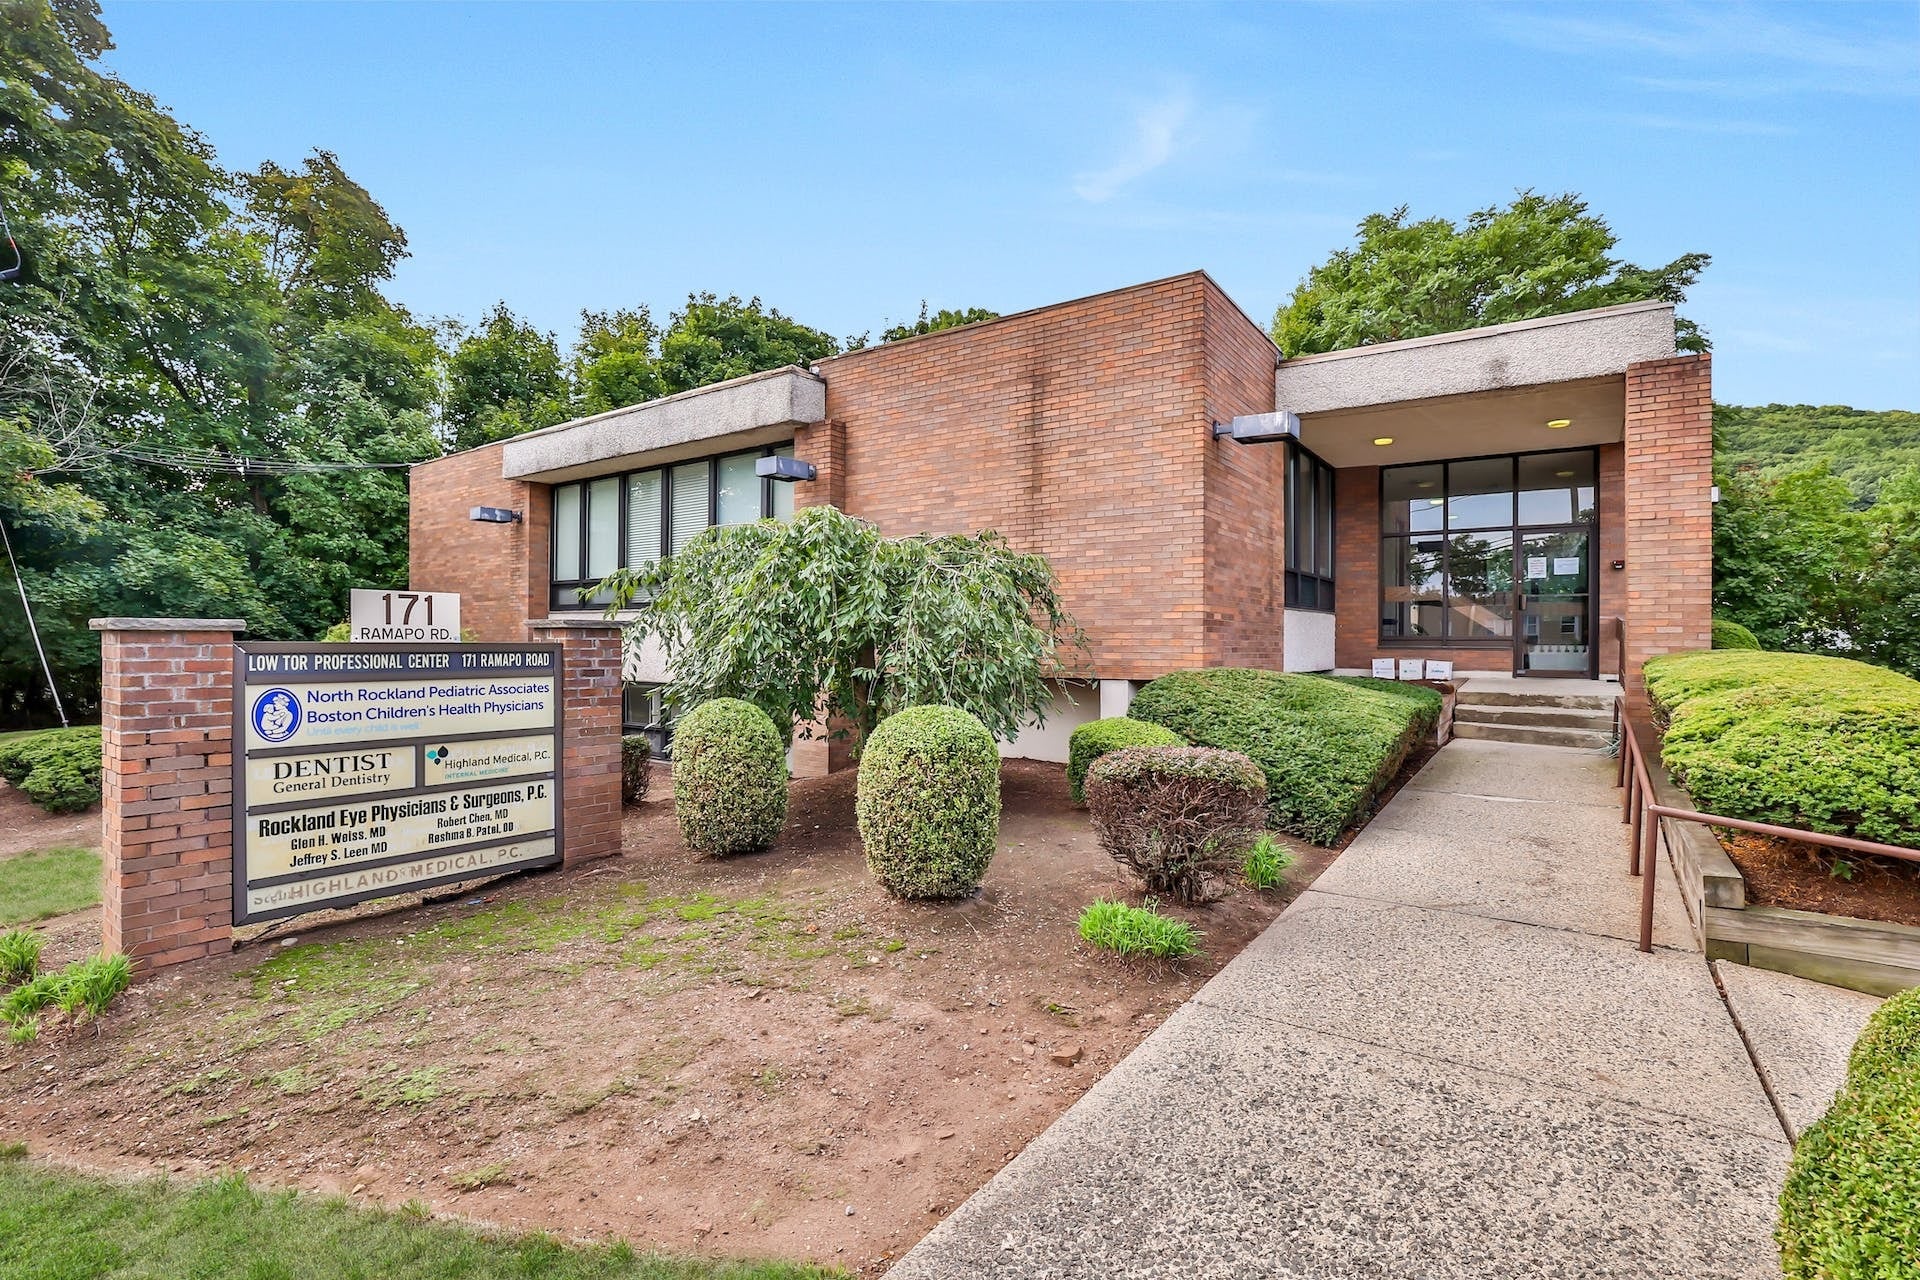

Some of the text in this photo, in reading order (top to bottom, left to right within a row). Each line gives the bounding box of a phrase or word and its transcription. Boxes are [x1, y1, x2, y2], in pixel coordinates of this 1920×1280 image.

[382, 593, 432, 625] 171
[361, 627, 452, 640] RAMAPO RD.
[248, 652, 549, 671] LOW TOR PROFESSIONAL CENTER 171 RAMAPO ROAD
[307, 682, 549, 703] North Rockland Pediatric Associates
[307, 700, 544, 723] Boston Children's Health Physicians
[273, 752, 392, 780] DENTIST
[444, 750, 550, 771] Highland Medical, P.C.
[273, 773, 390, 794] General Dentistry
[444, 767, 508, 780] INTERNAL MEDICINE
[259, 784, 547, 837] Rockland Eye Physicians & Surgeons, P.C.
[437, 815, 467, 829] Robert
[494, 808, 508, 820] MD
[291, 838, 316, 851] Glen
[318, 834, 328, 846] H.
[369, 826, 386, 839] MD
[428, 831, 465, 844] Reshma
[466, 827, 475, 838] B.
[503, 821, 514, 833] OD
[289, 841, 388, 868] Jeffrey S. Leen MD
[289, 869, 398, 900] HIGHLAND
[498, 846, 522, 859] P.C.
